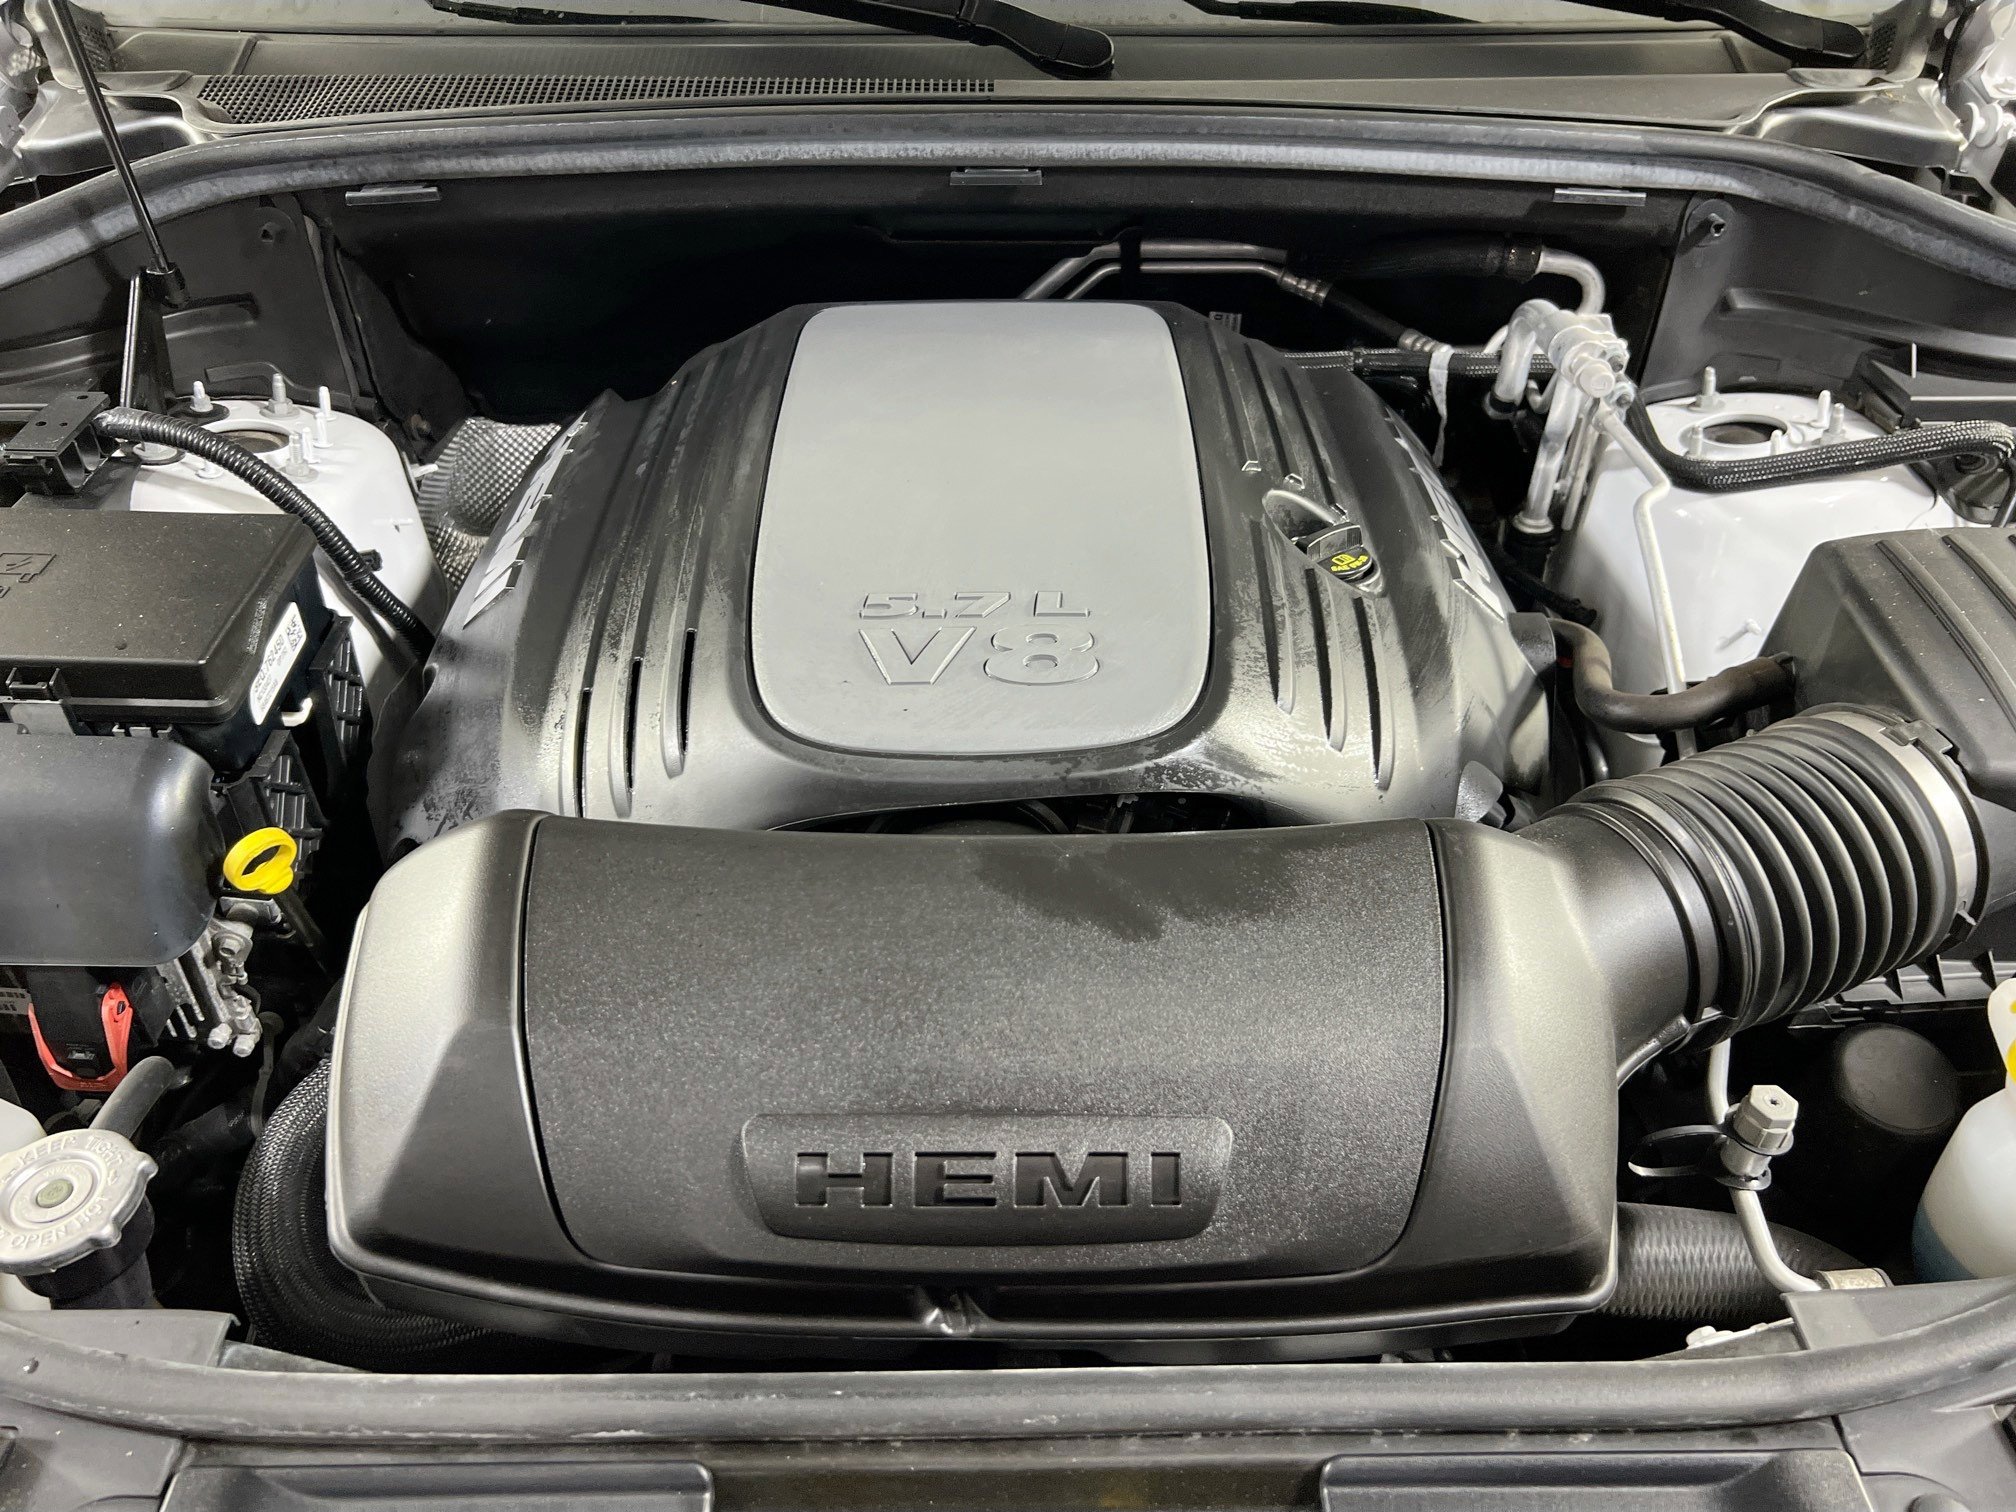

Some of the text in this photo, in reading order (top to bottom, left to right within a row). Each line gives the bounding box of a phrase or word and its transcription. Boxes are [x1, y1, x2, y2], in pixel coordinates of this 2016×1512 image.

[859, 591, 1011, 619] 5.7
[857, 624, 1100, 686] V8
[17, 1135, 78, 1166] KEEP
[796, 1151, 1182, 1207] HEMI
[10, 1226, 67, 1249] OPEN
